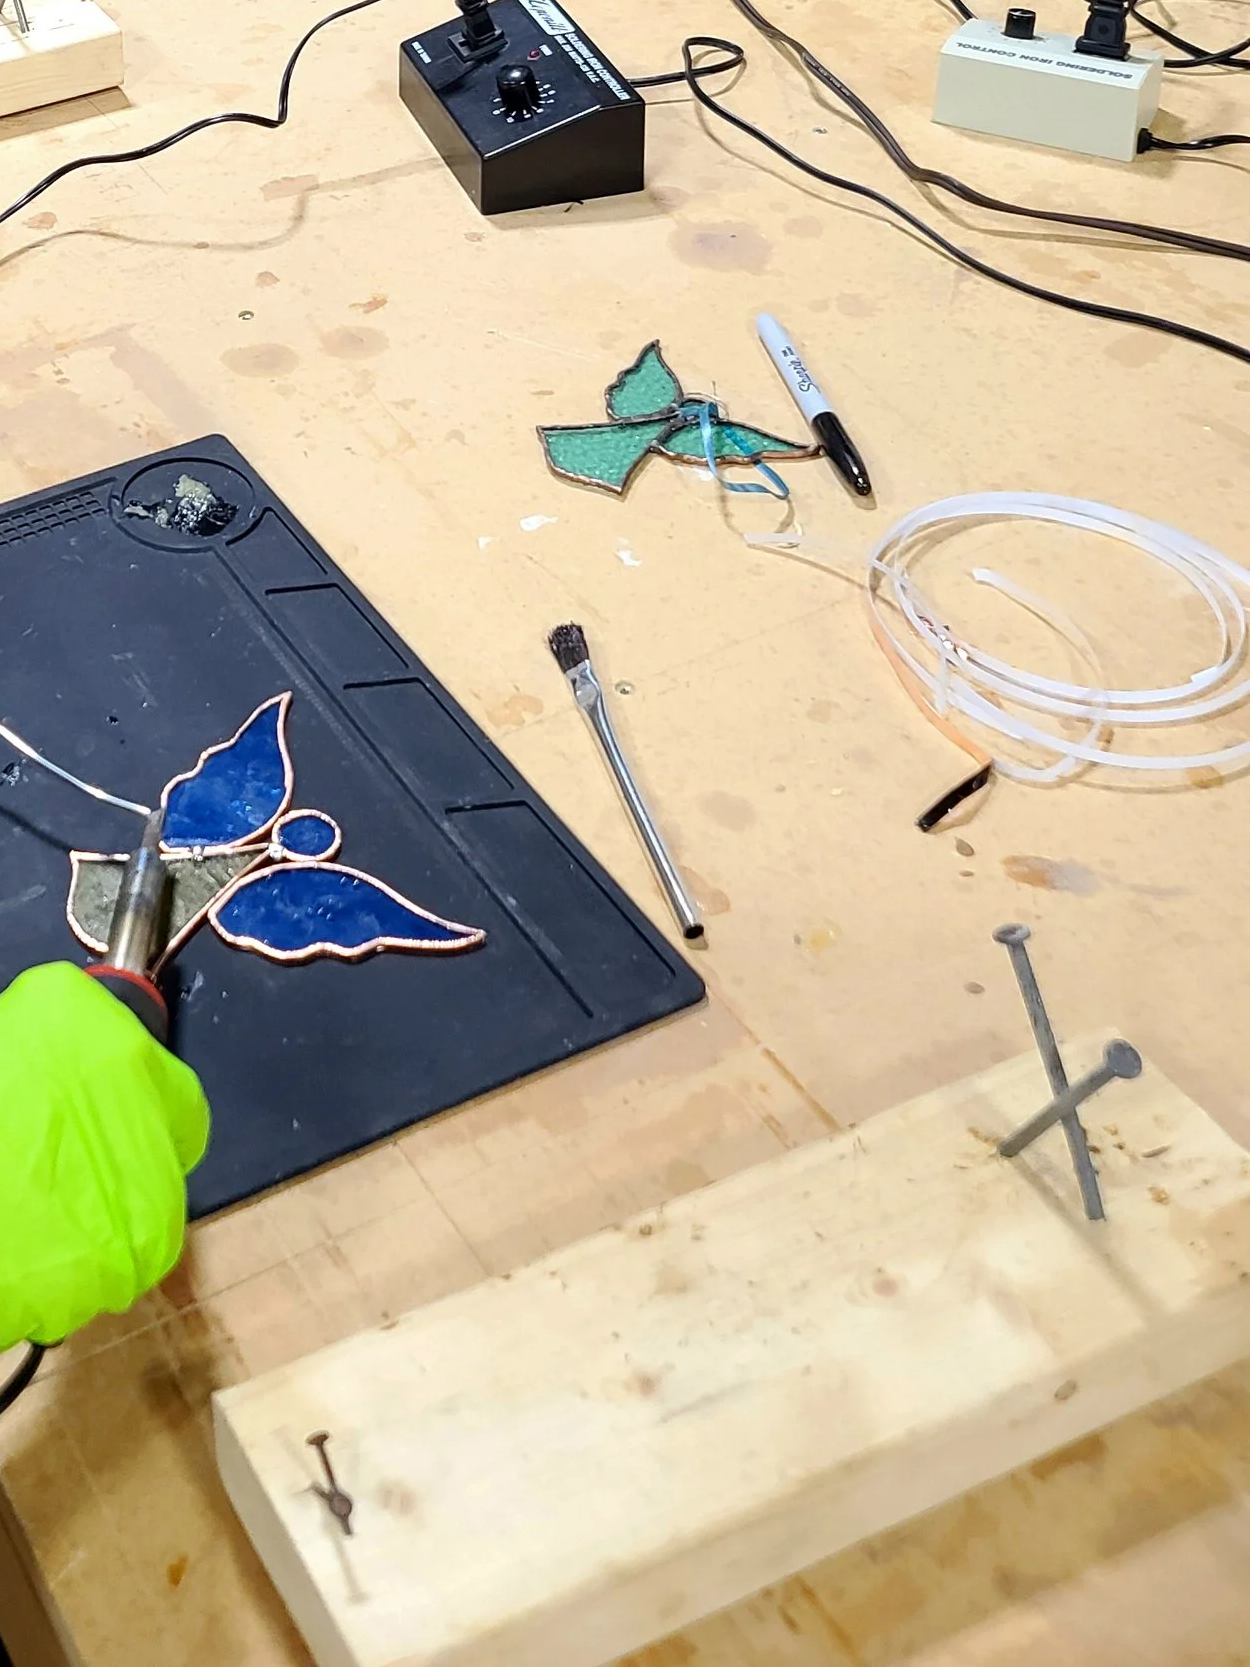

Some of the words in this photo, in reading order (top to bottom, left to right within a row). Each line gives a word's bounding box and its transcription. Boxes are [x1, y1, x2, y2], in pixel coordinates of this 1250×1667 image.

[955, 41, 1017, 58] CONTROL
[1019, 54, 1053, 65] IRON
[1055, 61, 1133, 80] SOLDERING
